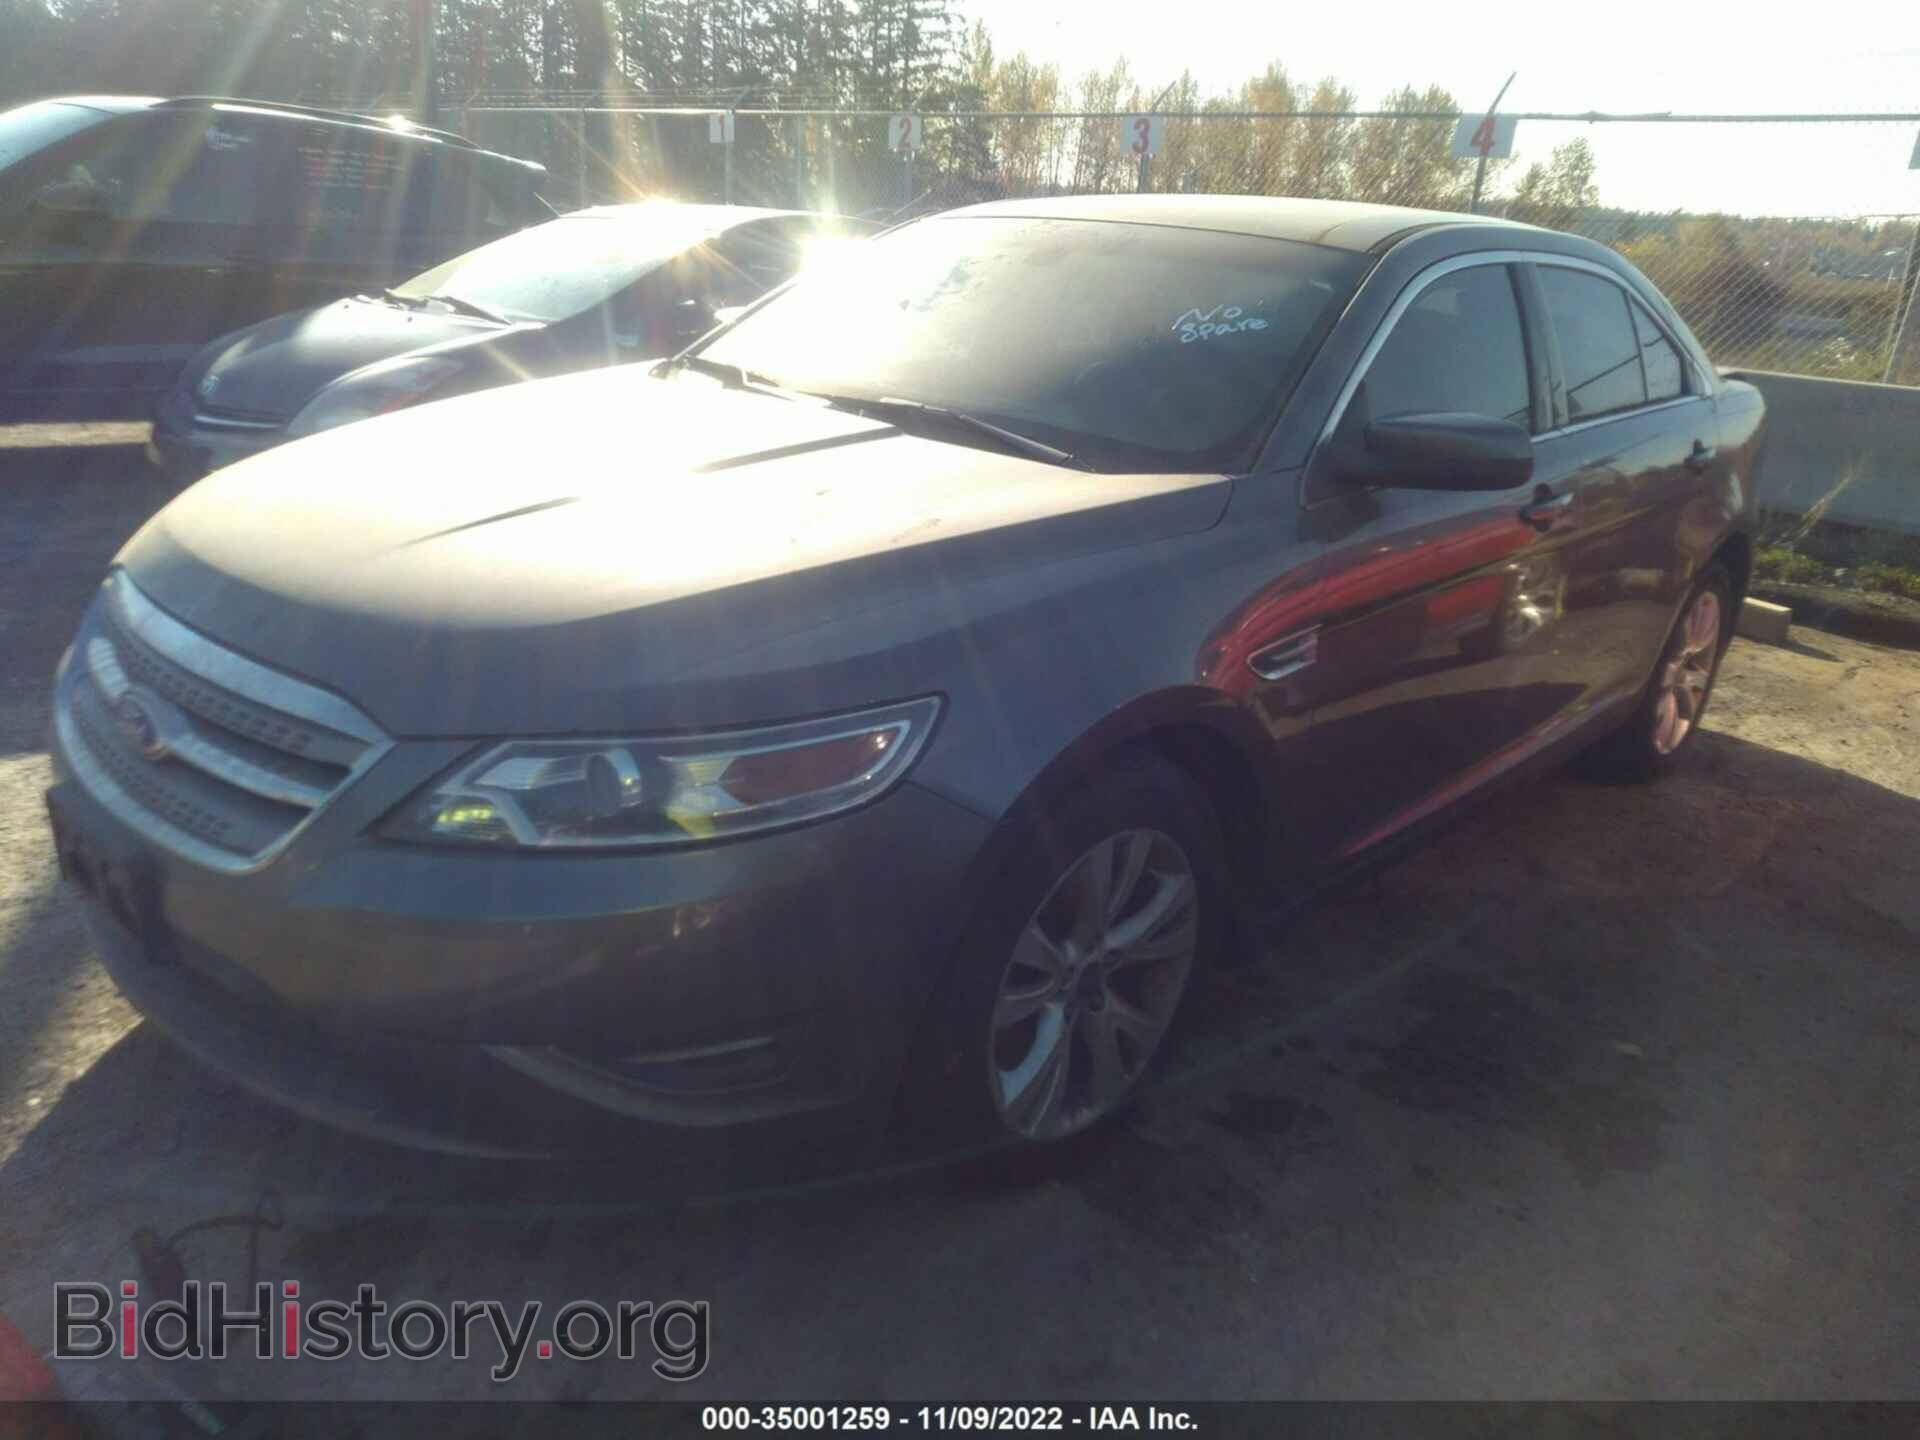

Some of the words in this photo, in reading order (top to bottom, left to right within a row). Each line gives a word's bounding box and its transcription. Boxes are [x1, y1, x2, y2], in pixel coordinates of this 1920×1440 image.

[898, 117, 912, 149] 2
[1131, 117, 1151, 154] 3
[1469, 115, 1496, 154] 4
